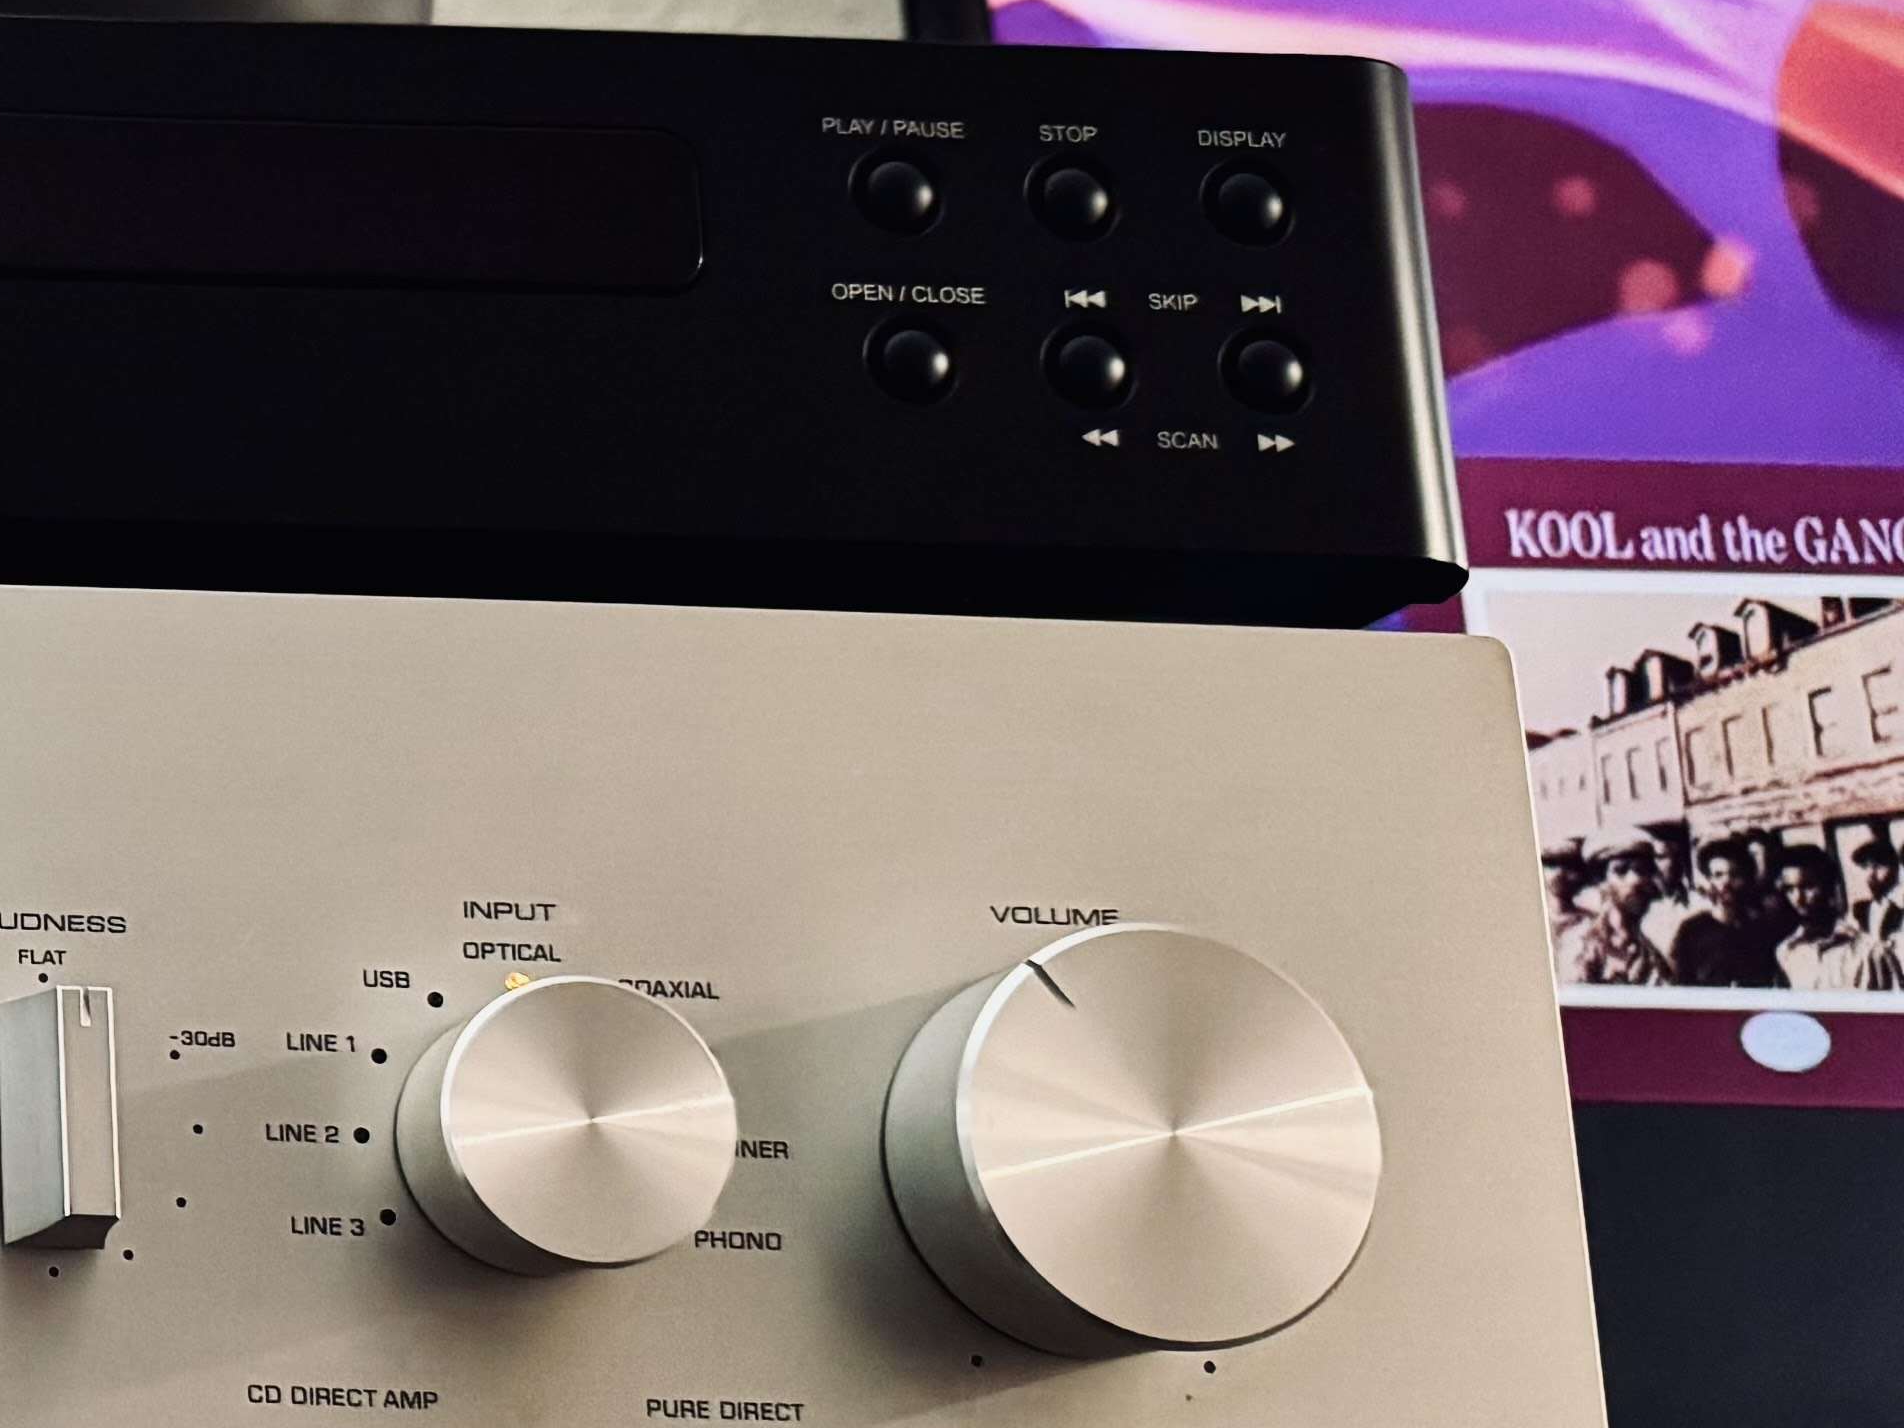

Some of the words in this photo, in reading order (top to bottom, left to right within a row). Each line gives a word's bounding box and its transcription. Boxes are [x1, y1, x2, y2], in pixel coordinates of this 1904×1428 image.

[822, 116, 875, 135] PLAY
[892, 119, 964, 139] PAUSE
[1039, 124, 1098, 143] STOP
[1197, 129, 1286, 148] DISPLAY
[831, 283, 893, 301] OPEN
[911, 285, 985, 305] CLOSE
[1148, 292, 1198, 311] SKIP
[1157, 430, 1219, 450] SCAN
[1505, 509, 1635, 560] KOOL
[1640, 514, 1716, 561] and
[1722, 515, 1788, 563] the
[463, 901, 557, 922] INPUT
[989, 905, 1119, 927] VOLUME
[18, 948, 67, 965] FLAT
[462, 941, 562, 963] OPTICAL
[363, 969, 411, 989] USB
[286, 1032, 338, 1053] LINE
[345, 1035, 356, 1053] 1
[265, 1123, 318, 1144] LINE
[324, 1125, 340, 1144] 2
[290, 1216, 343, 1237] LINE
[349, 1218, 366, 1237] 3
[694, 1229, 782, 1251] PHONO
[247, 1384, 282, 1404] CD
[290, 1385, 378, 1408] DIRECT
[383, 1389, 439, 1410] AMP
[646, 1398, 710, 1420] PURE
[719, 1400, 805, 1422] DIRECT
